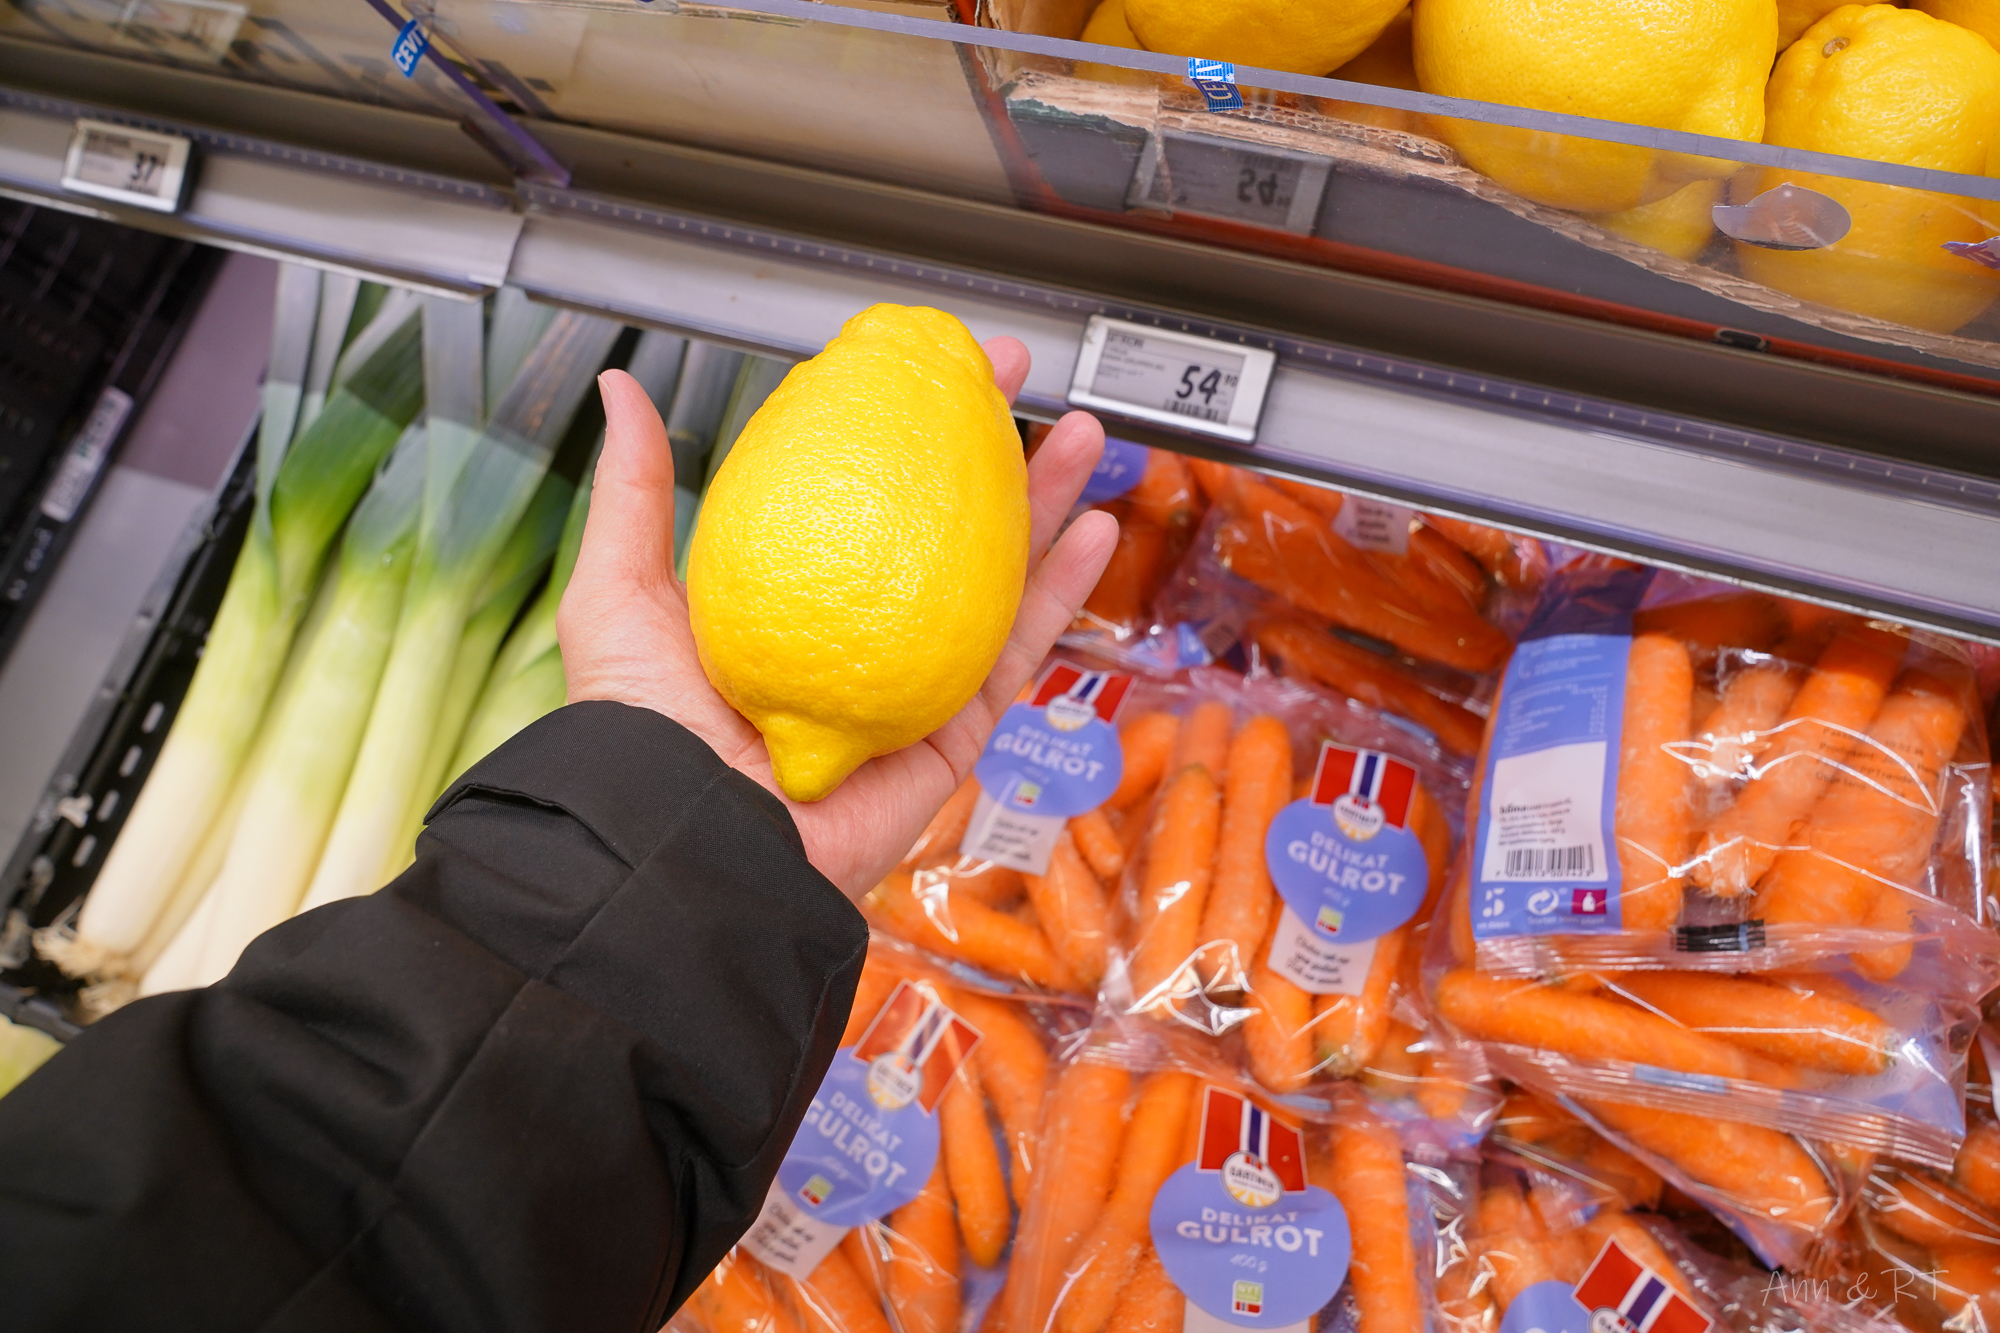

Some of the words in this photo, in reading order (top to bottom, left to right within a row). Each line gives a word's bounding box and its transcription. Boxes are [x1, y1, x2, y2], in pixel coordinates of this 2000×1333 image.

[1176, 365, 1222, 405] 54
[993, 732, 1104, 781] GULROT
[1287, 839, 1405, 895] GULROT
[1310, 831, 1389, 870] DELIKAT
[803, 1099, 907, 1187] GULROT
[829, 1090, 903, 1152] DELIKAT
[1201, 1206, 1299, 1226] DELIKAT
[1176, 1220, 1324, 1257] GULROT
